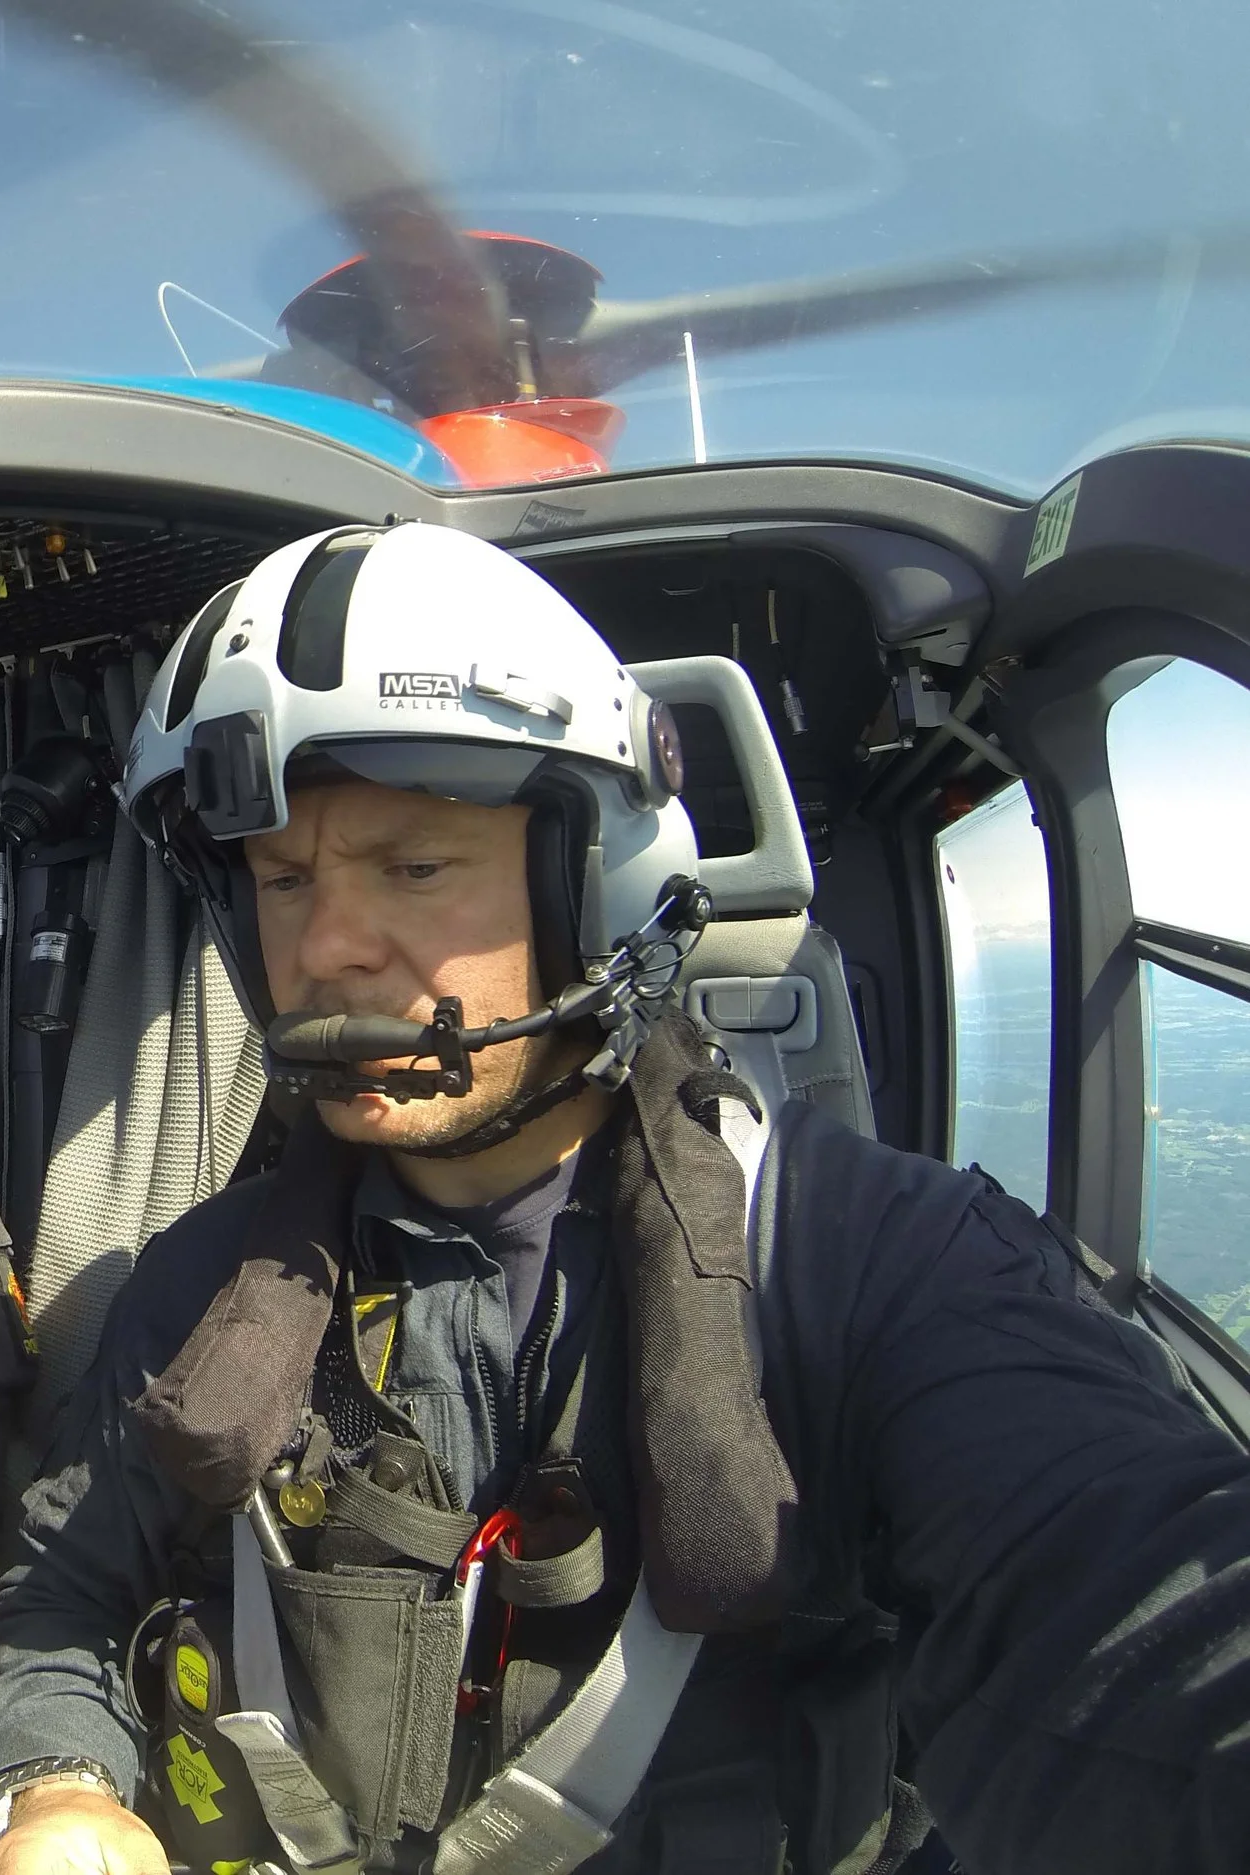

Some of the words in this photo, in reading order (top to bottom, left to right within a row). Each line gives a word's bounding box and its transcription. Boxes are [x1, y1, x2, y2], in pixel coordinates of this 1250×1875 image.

[1027, 488, 1077, 566] EXIT
[382, 674, 458, 697] MSA
[379, 699, 462, 711] GALLET
[177, 1761, 207, 1797] ACR
